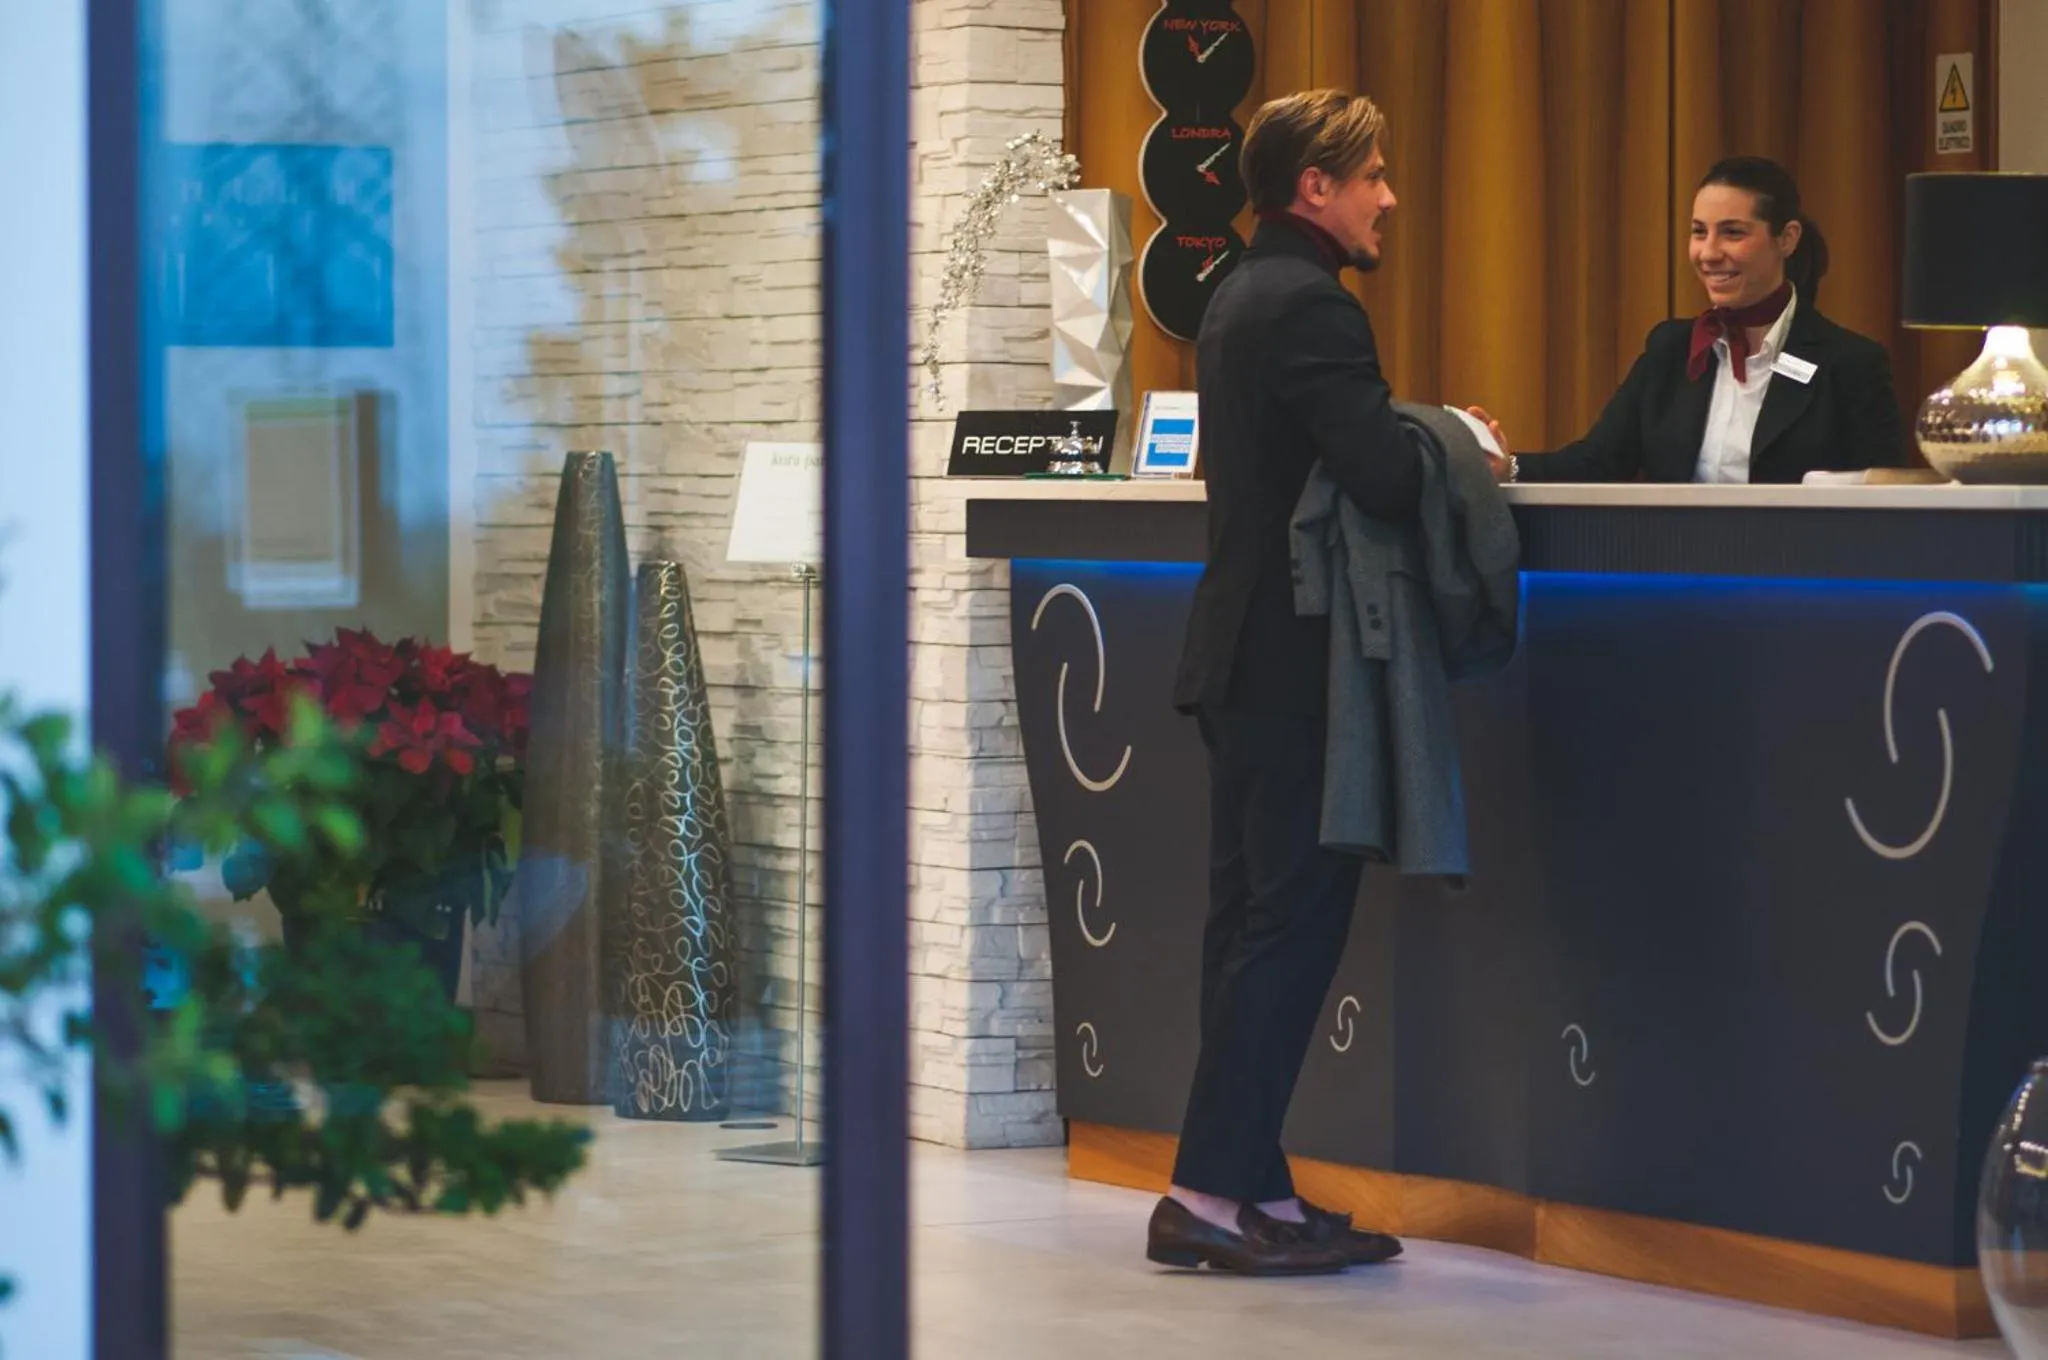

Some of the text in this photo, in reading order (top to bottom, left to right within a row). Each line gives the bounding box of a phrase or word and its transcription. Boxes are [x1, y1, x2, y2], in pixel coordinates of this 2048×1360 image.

[1164, 19, 1240, 34] NEW YORK
[1171, 127, 1231, 140] LONDRA
[1176, 234, 1227, 252] TOKYO
